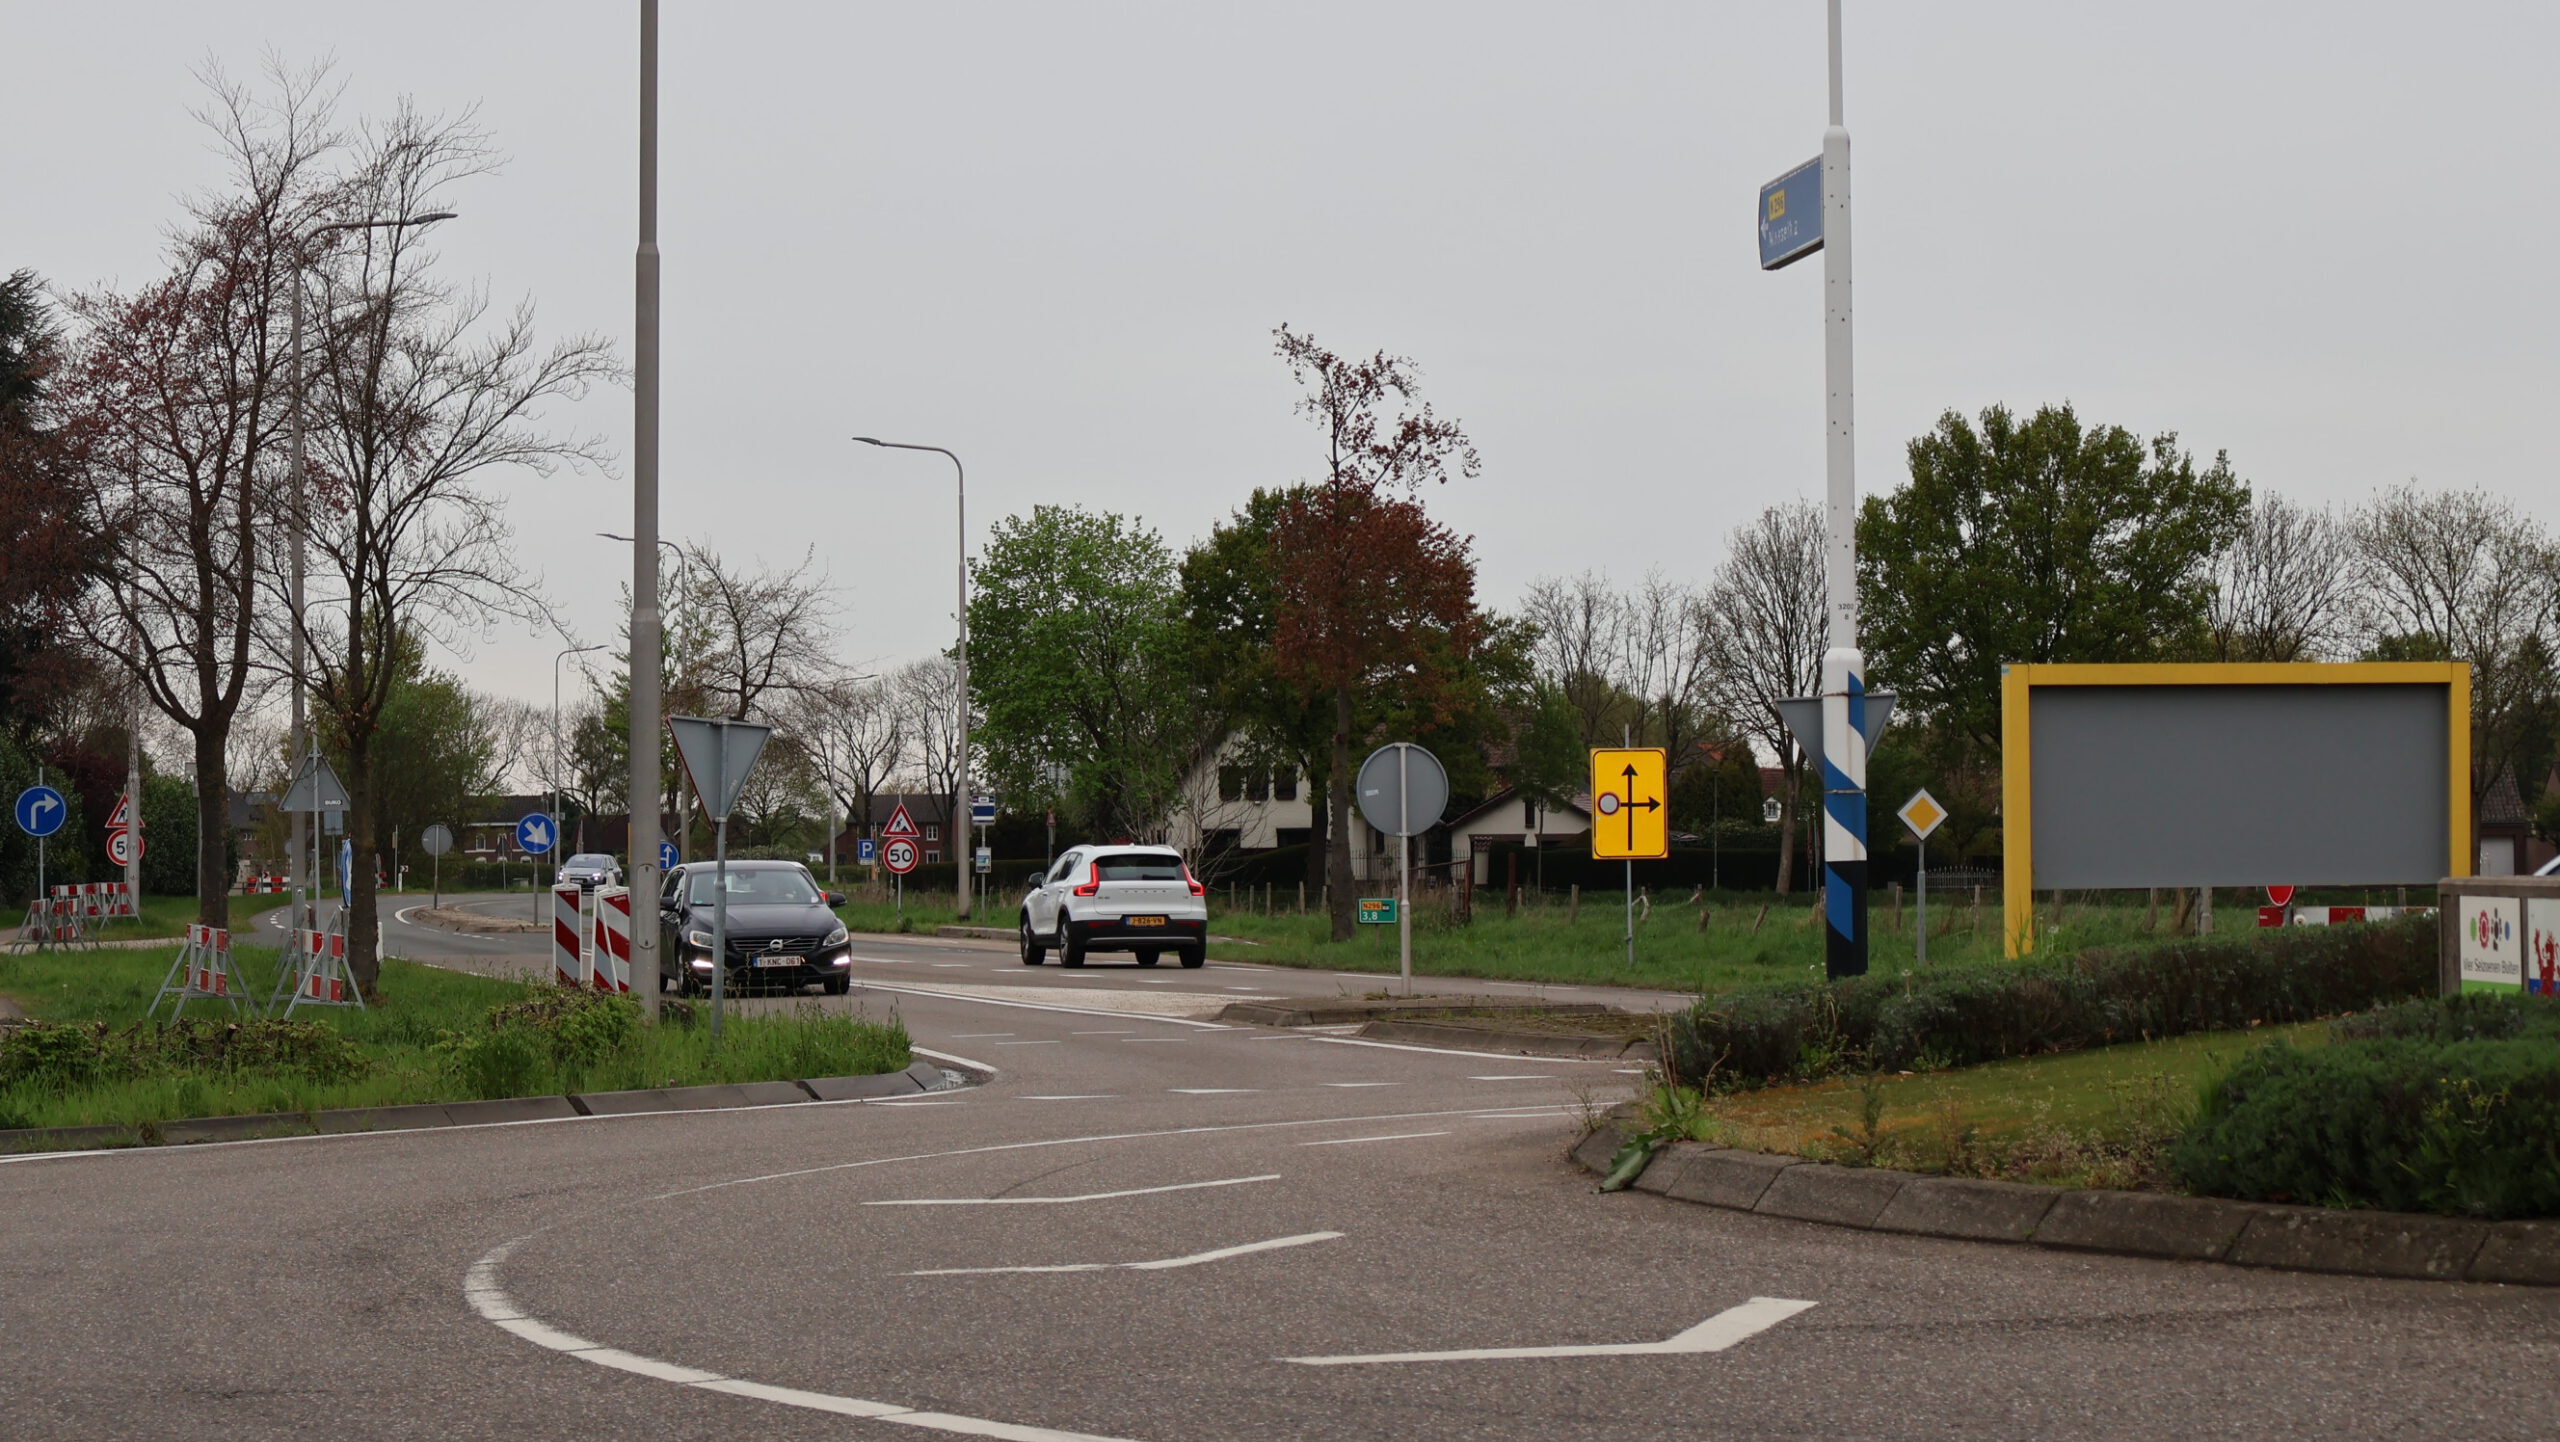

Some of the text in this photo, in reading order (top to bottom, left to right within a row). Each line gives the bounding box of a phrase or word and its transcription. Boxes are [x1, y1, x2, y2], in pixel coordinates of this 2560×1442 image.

[1794, 220, 1799, 236] 2
[862, 842, 873, 857] P
[890, 849, 913, 863] 50
[1362, 911, 1378, 920] 3.8
